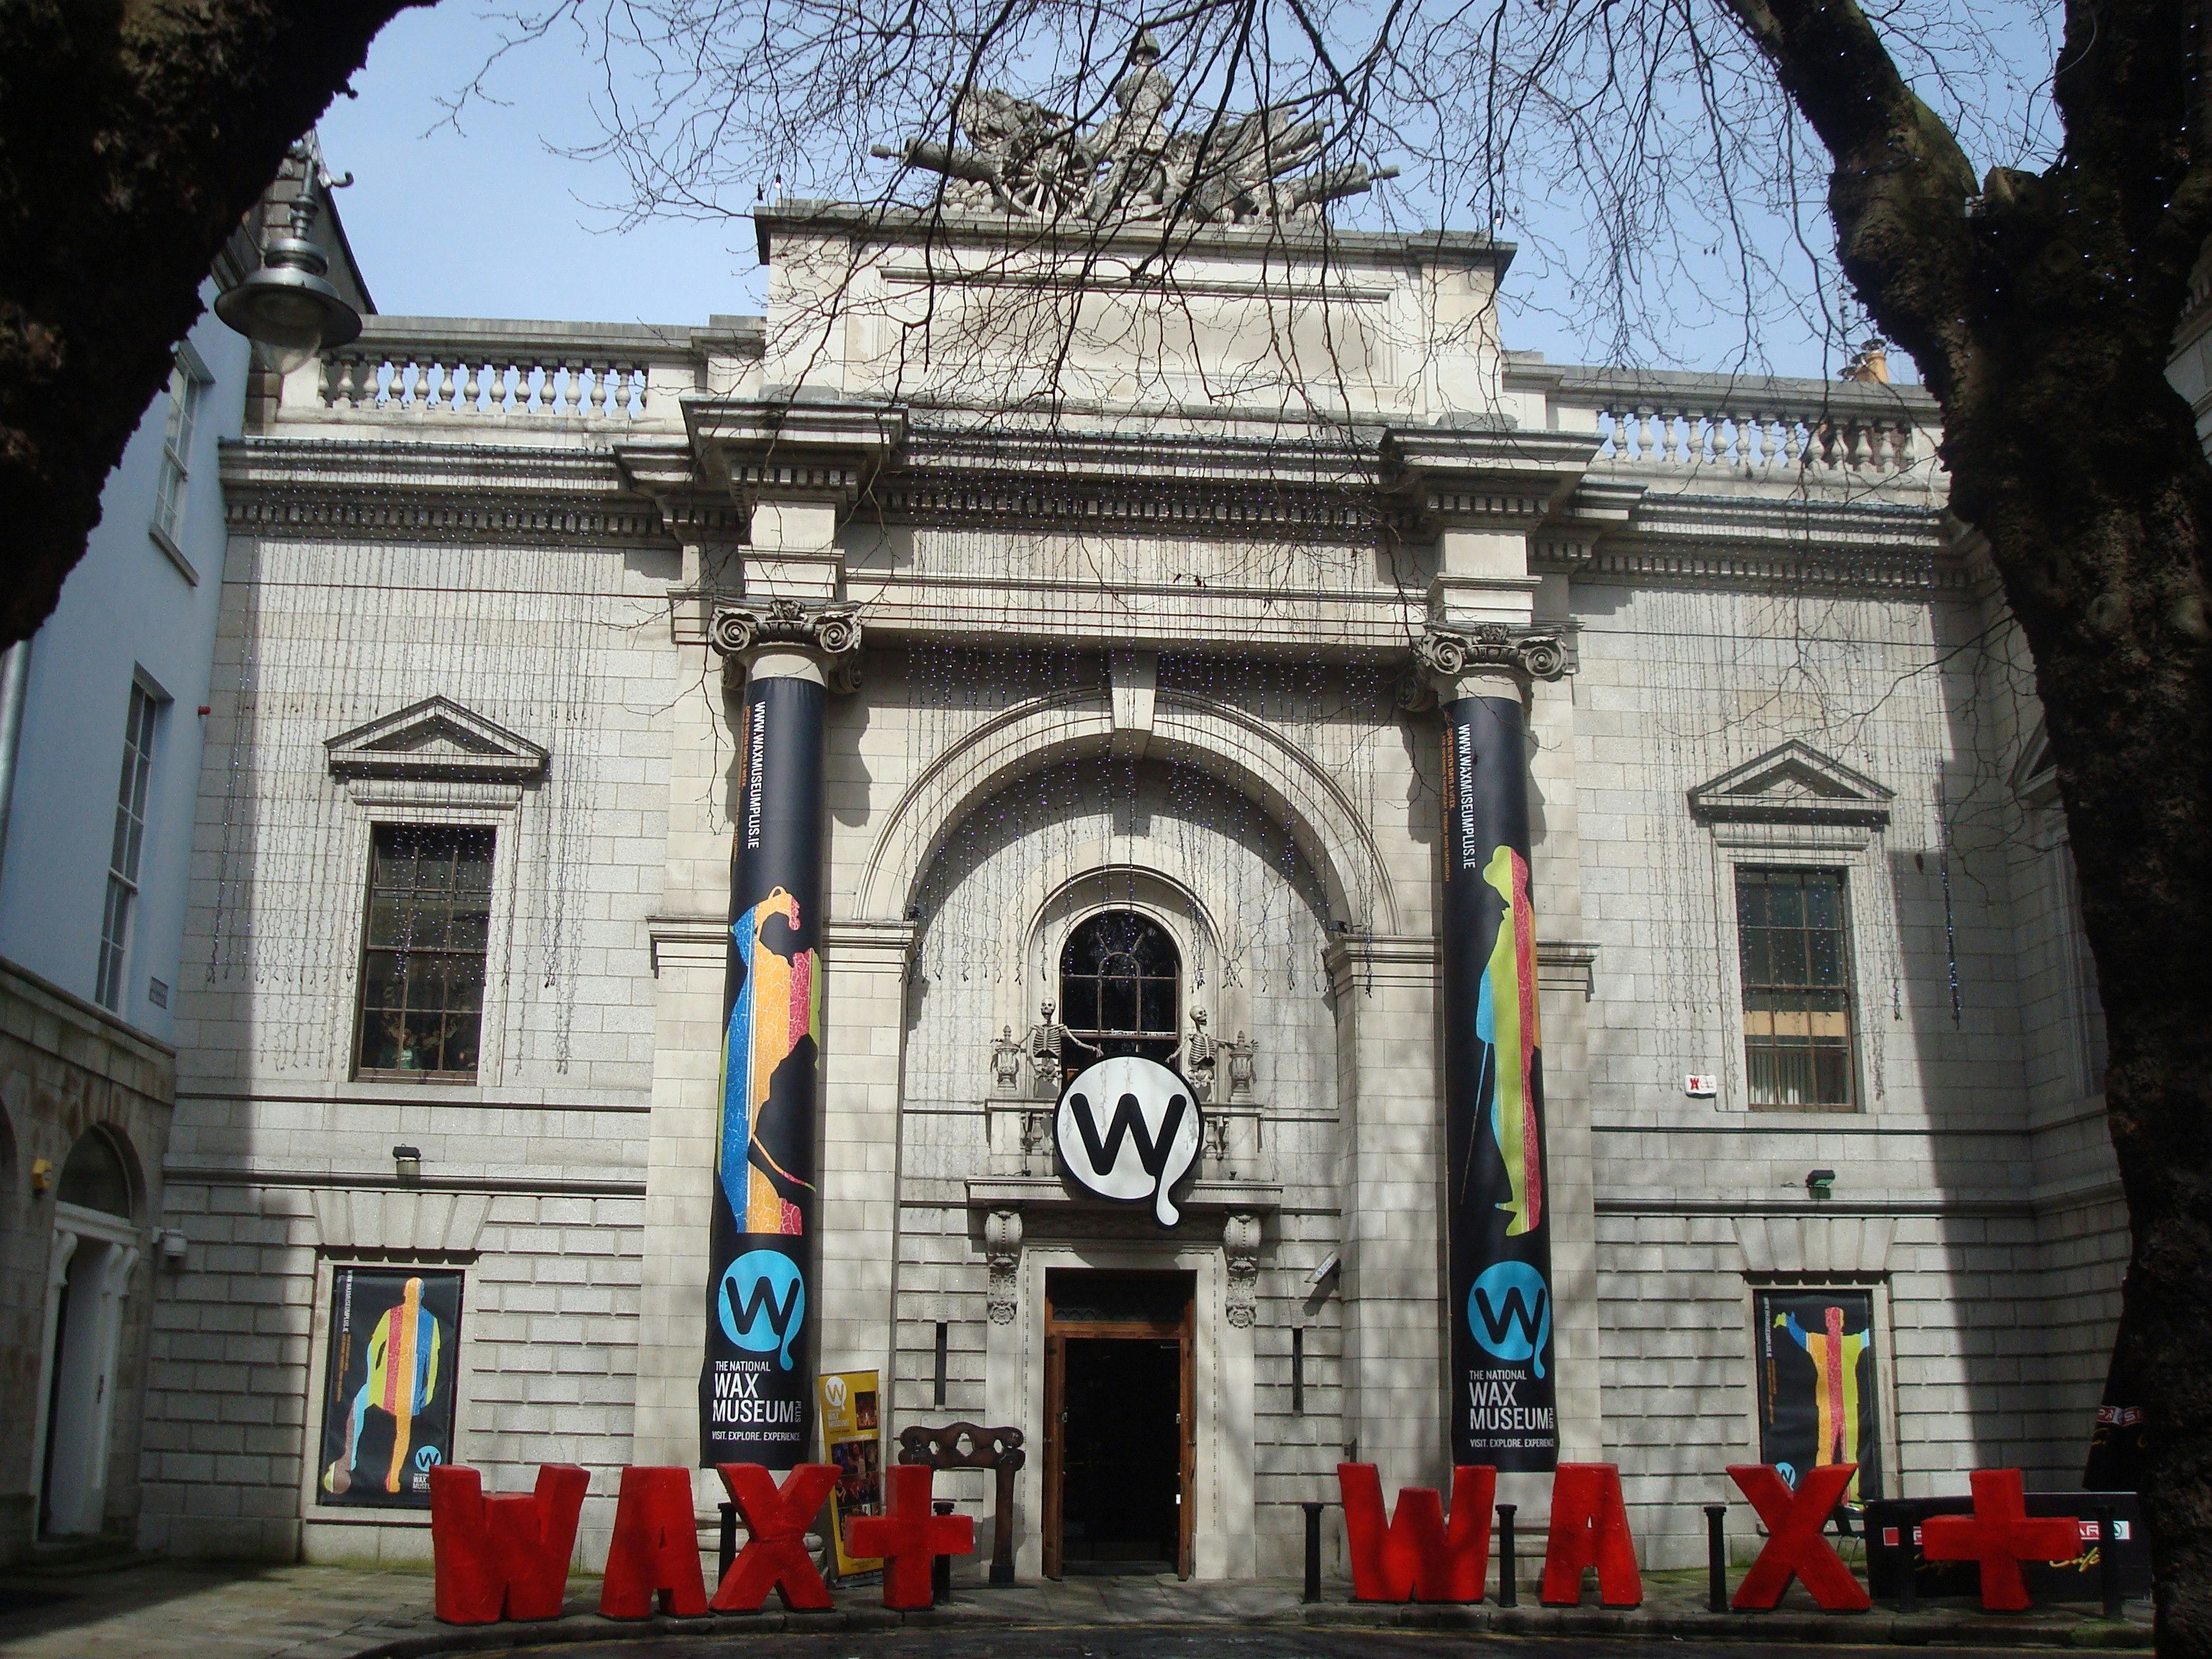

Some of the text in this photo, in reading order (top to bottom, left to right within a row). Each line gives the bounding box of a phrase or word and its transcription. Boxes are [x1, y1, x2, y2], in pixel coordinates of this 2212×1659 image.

[747, 701, 766, 850] WWW.WAXMUSEUMPLUS.IE
[1458, 724, 1476, 869] WWW.WAXMUSEUMPLUS.IE
[716, 1361, 770, 1372] THE NATIONAL
[1469, 1370, 1527, 1380] THE NATIONAL
[714, 1373, 759, 1398] WAX
[1469, 1382, 1517, 1406] WAX
[712, 1400, 793, 1423] MUSEUM
[1470, 1408, 1548, 1430] MUSEUM
[729, 1431, 762, 1440] EXPLORE.
[1470, 1439, 1488, 1447] VISIT.
[1490, 1439, 1523, 1447] EXPLORE.
